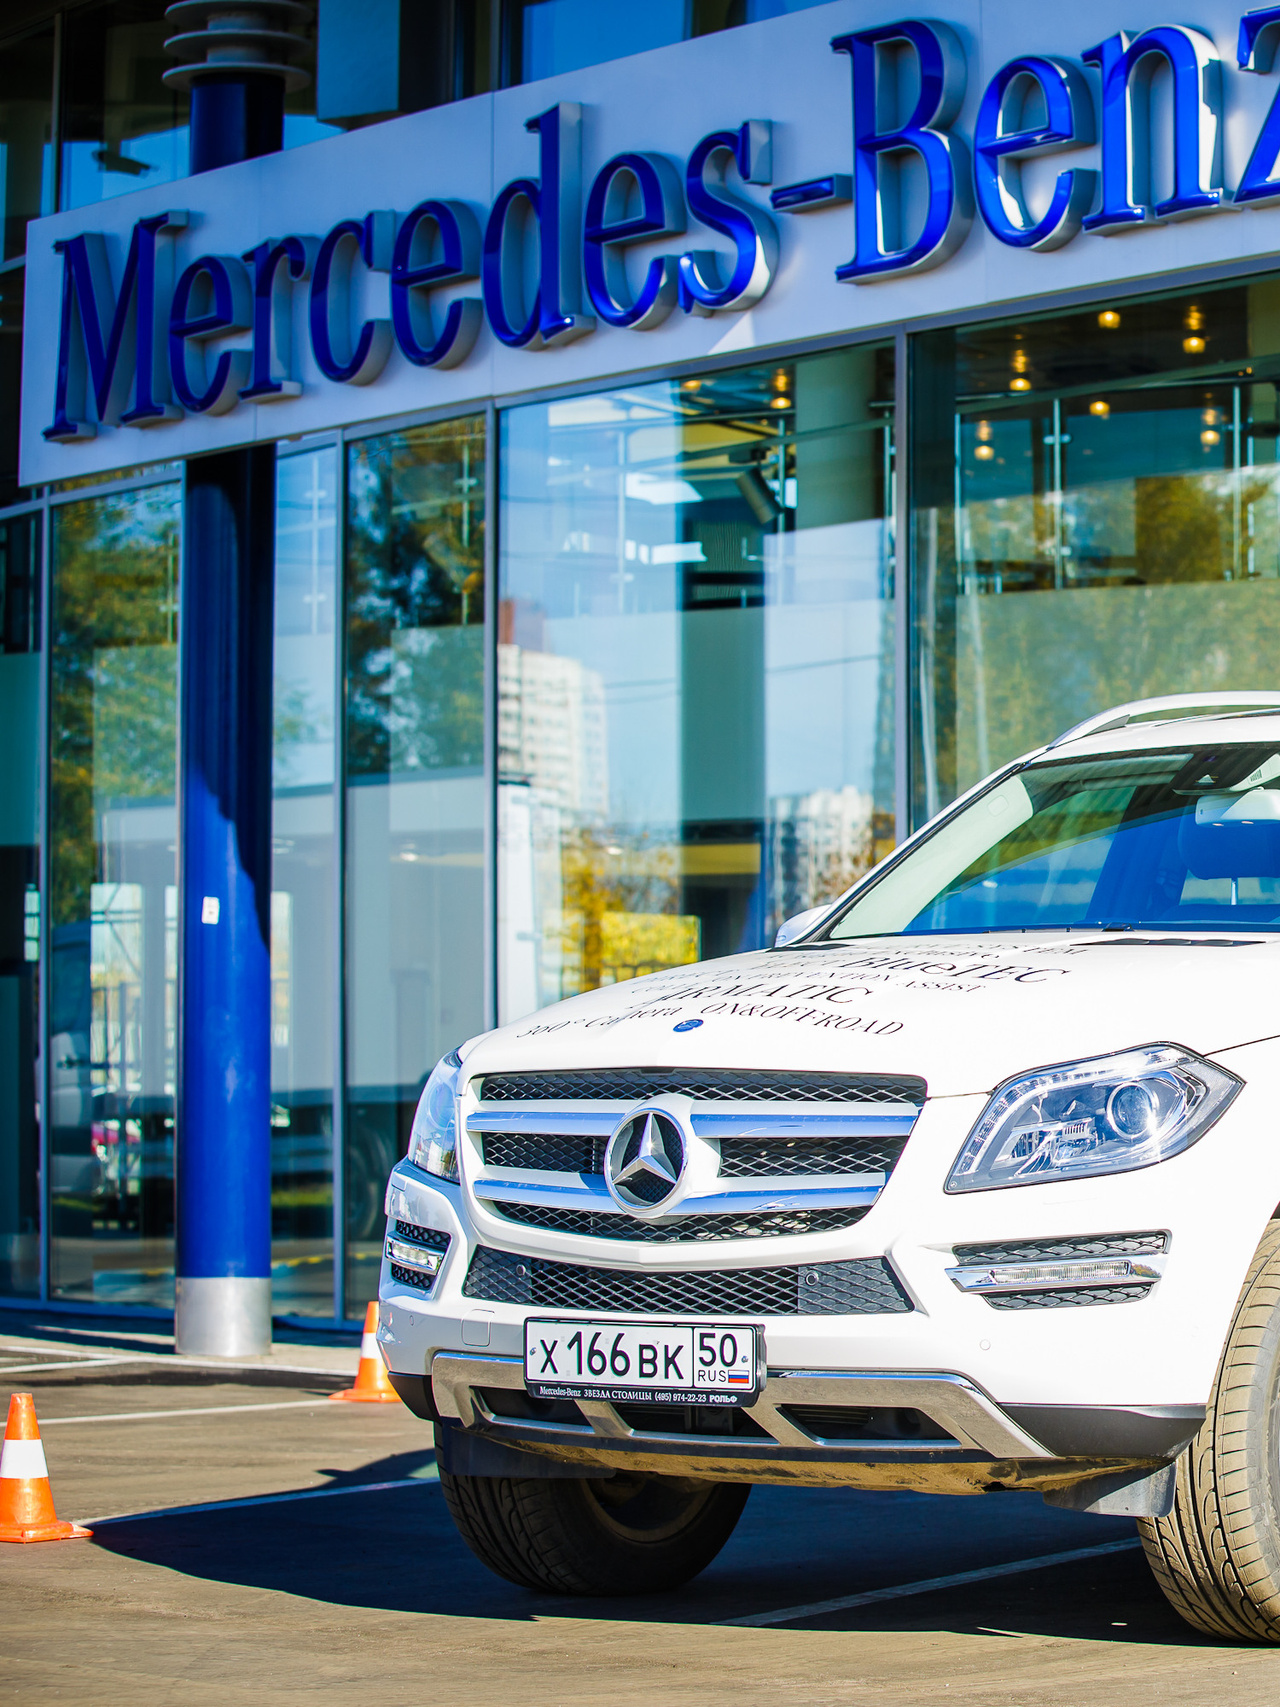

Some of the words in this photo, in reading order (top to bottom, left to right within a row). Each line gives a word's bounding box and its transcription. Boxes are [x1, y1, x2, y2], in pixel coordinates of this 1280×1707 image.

[838, 957, 1072, 983] BlueTEC
[893, 980, 987, 993] ASSIST
[700, 1002, 905, 1036] ON&OFFROAD
[698, 1332, 738, 1368] 50
[697, 1369, 727, 1383] RUS
[539, 1385, 582, 1397] Mercedes-Benz
[583, 1388, 611, 1400] ЗВЕЗДА
[610, 1389, 652, 1401] СТОЛИЦЫ
[654, 1391, 672, 1403] (495)
[672, 1392, 707, 1404] 974-22-23
[709, 1393, 738, 1404] РОЛЬФ
